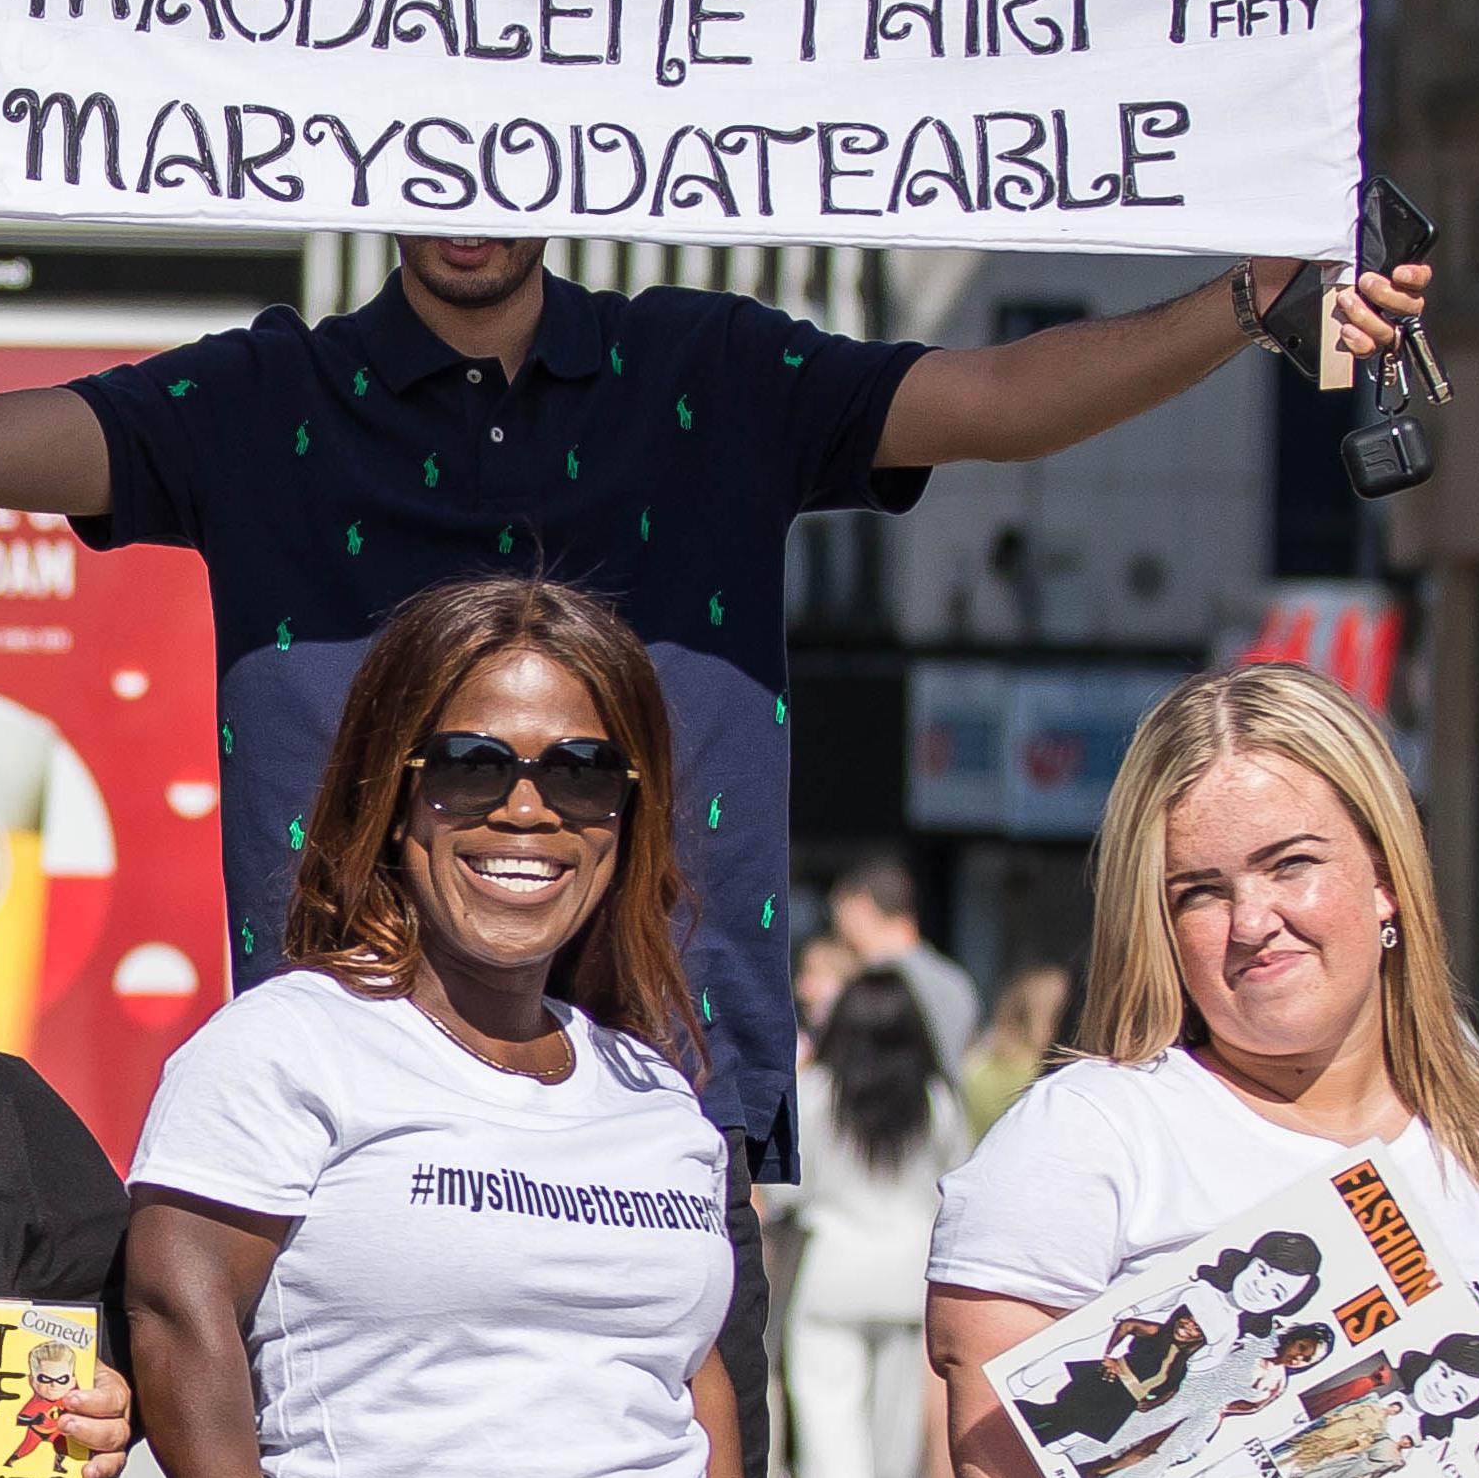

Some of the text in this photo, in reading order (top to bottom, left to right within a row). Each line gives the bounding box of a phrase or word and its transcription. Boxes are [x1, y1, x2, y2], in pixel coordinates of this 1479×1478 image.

[3, 87, 1191, 218] MARYSODATEABLE
[1332, 1160, 1443, 1307] FASHION
[21, 1309, 93, 1350] Comedy
[1334, 1286, 1398, 1344] IS
